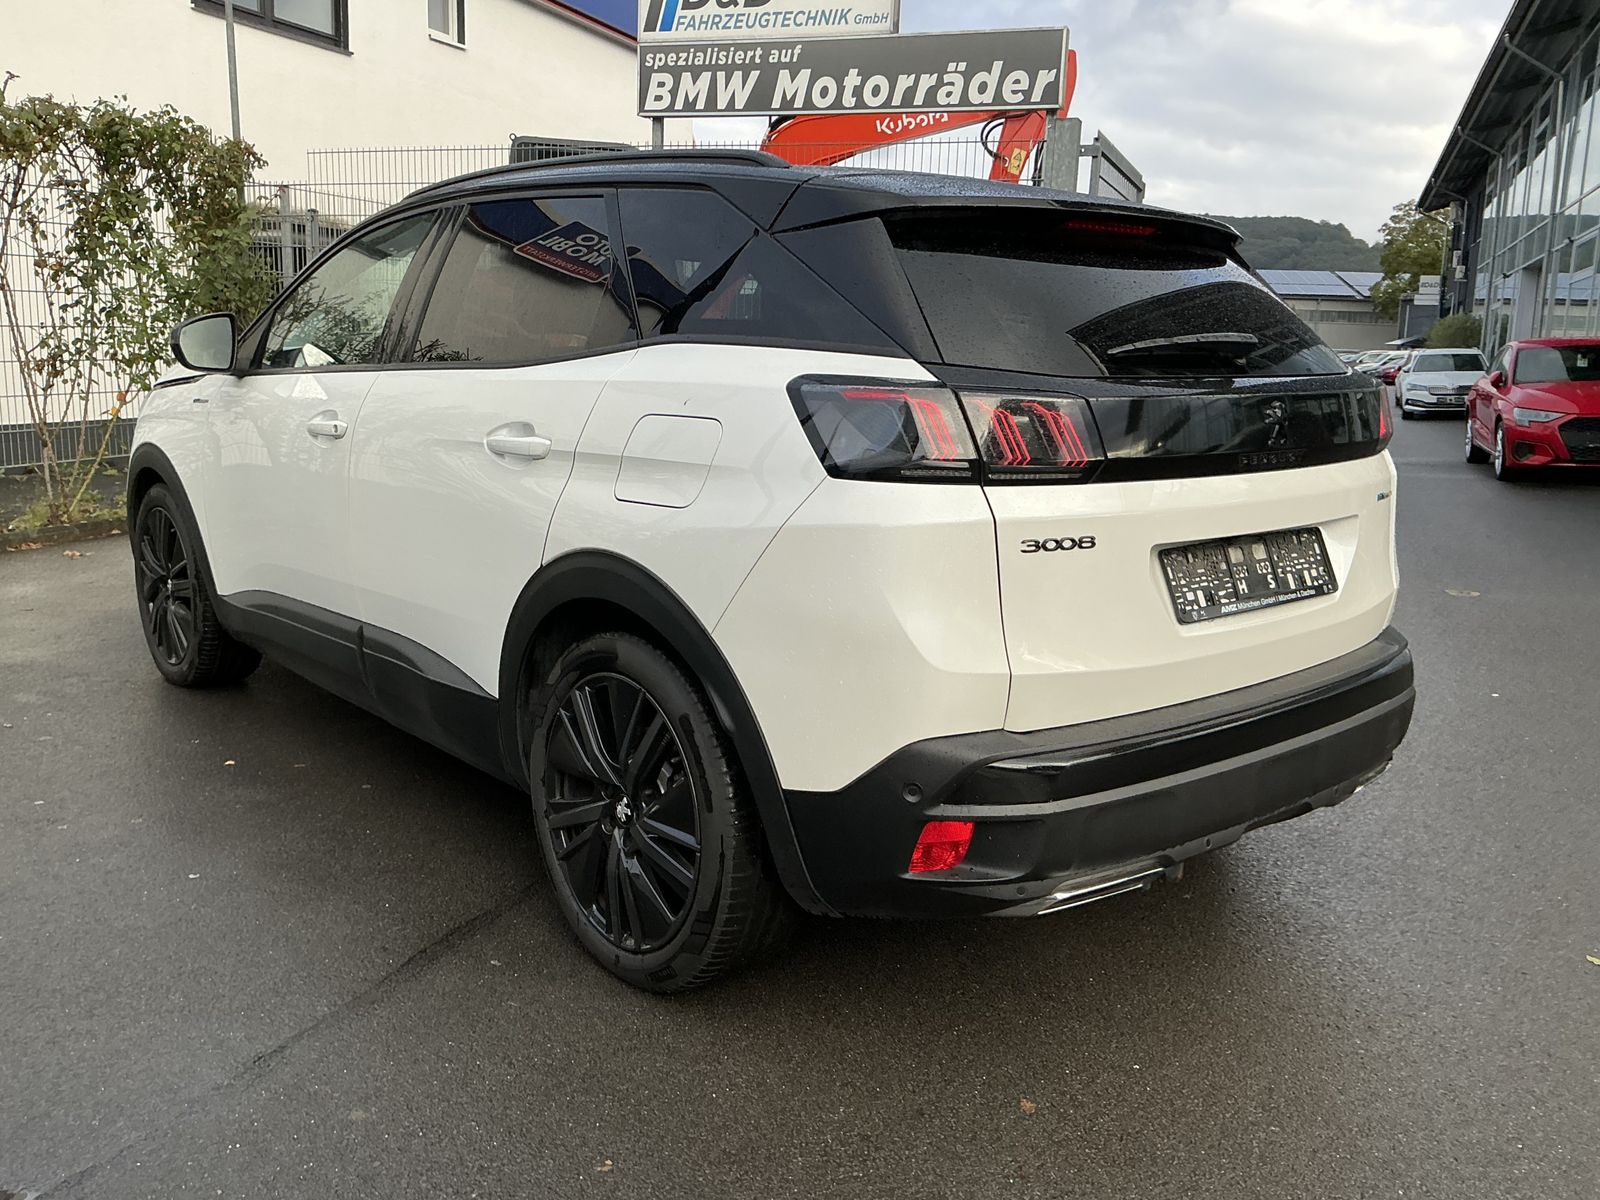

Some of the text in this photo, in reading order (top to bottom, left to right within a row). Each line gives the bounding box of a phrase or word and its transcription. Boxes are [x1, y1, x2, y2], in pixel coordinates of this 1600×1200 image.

[675, 9, 889, 31] FAHRZEUGTECHNIK GmbH
[645, 45, 802, 69] spezialisiert auf
[644, 61, 1057, 110] BMW Motorräder
[1020, 536, 1096, 553] 3008
